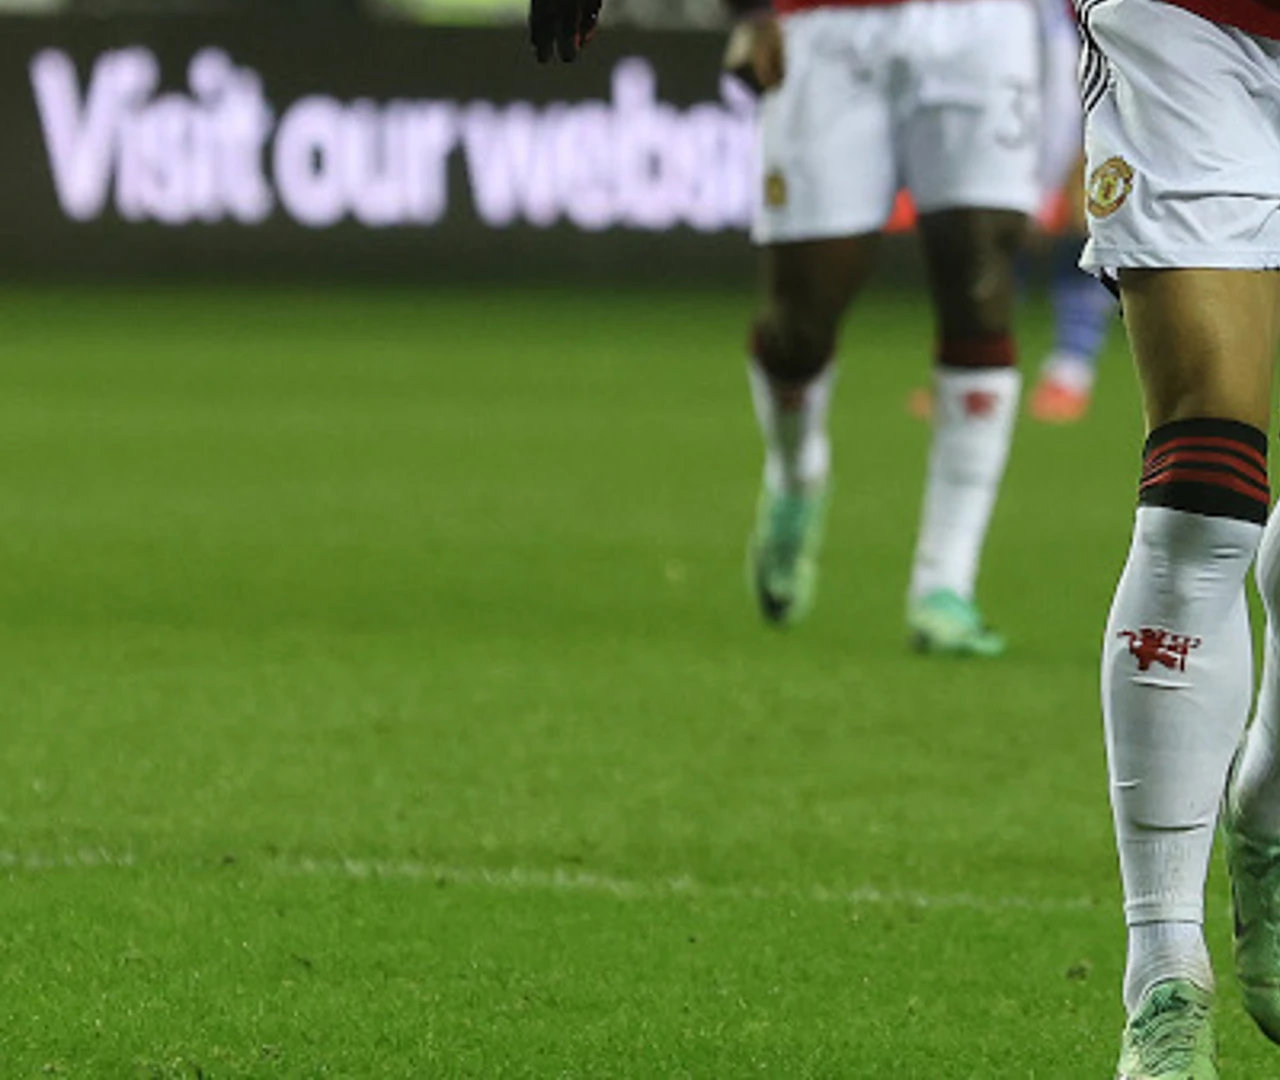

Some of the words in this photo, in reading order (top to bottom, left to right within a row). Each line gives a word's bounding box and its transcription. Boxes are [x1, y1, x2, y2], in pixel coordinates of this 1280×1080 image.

[29, 46, 270, 223] Visit
[273, 95, 461, 226] our
[462, 56, 760, 228] websi
